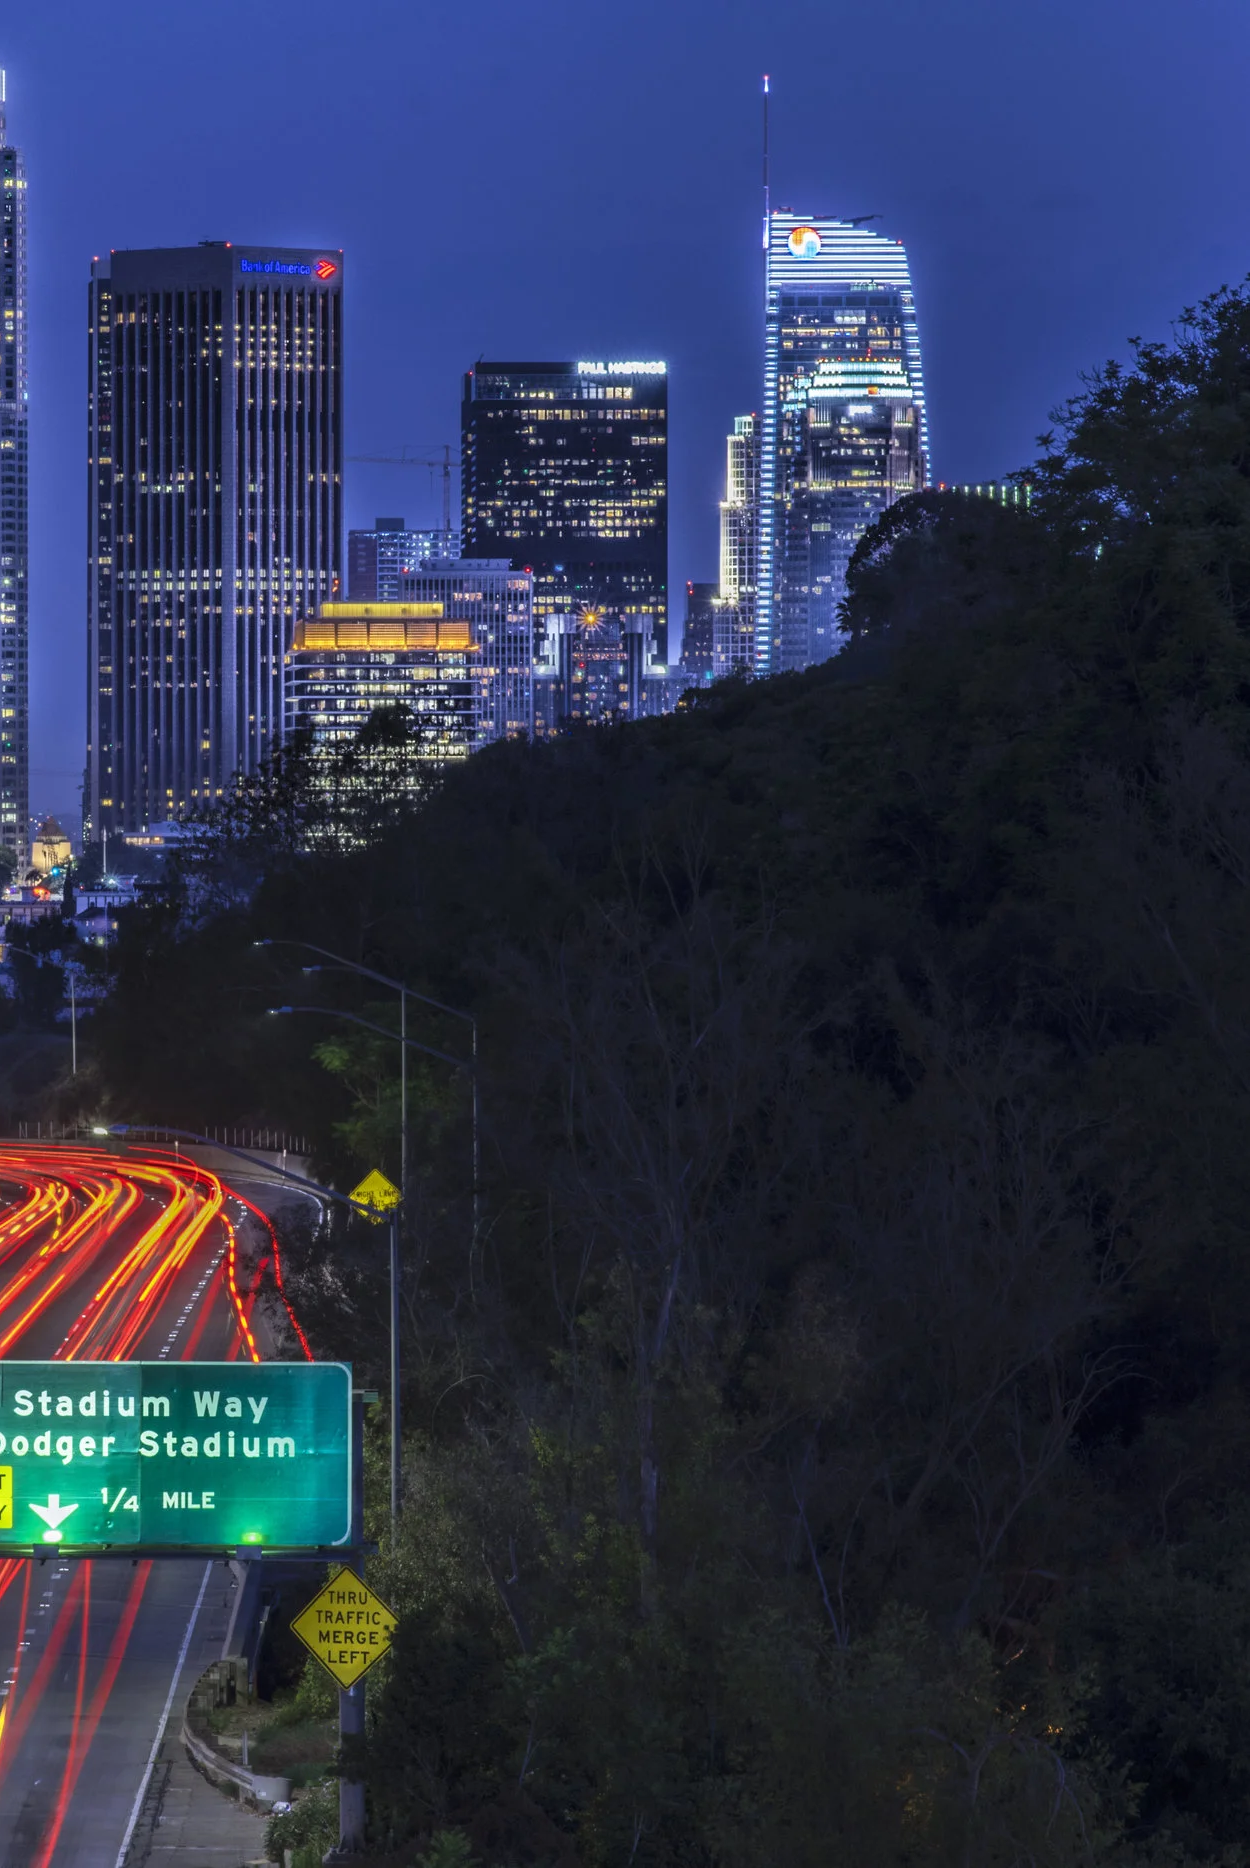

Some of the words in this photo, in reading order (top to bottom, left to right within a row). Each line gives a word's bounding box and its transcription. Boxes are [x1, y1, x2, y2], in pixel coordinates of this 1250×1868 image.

[241, 259, 263, 273] Bank
[264, 260, 274, 273] of
[275, 260, 311, 275] America
[13, 1389, 170, 1418] Stadium
[193, 1390, 269, 1424] Way
[139, 1430, 296, 1458] Stadium
[162, 1490, 216, 1510] MILE
[328, 1591, 368, 1605] THRU
[316, 1610, 381, 1625] TRAFFIC
[318, 1630, 378, 1645] MERGE
[328, 1650, 370, 1665] LEFT
